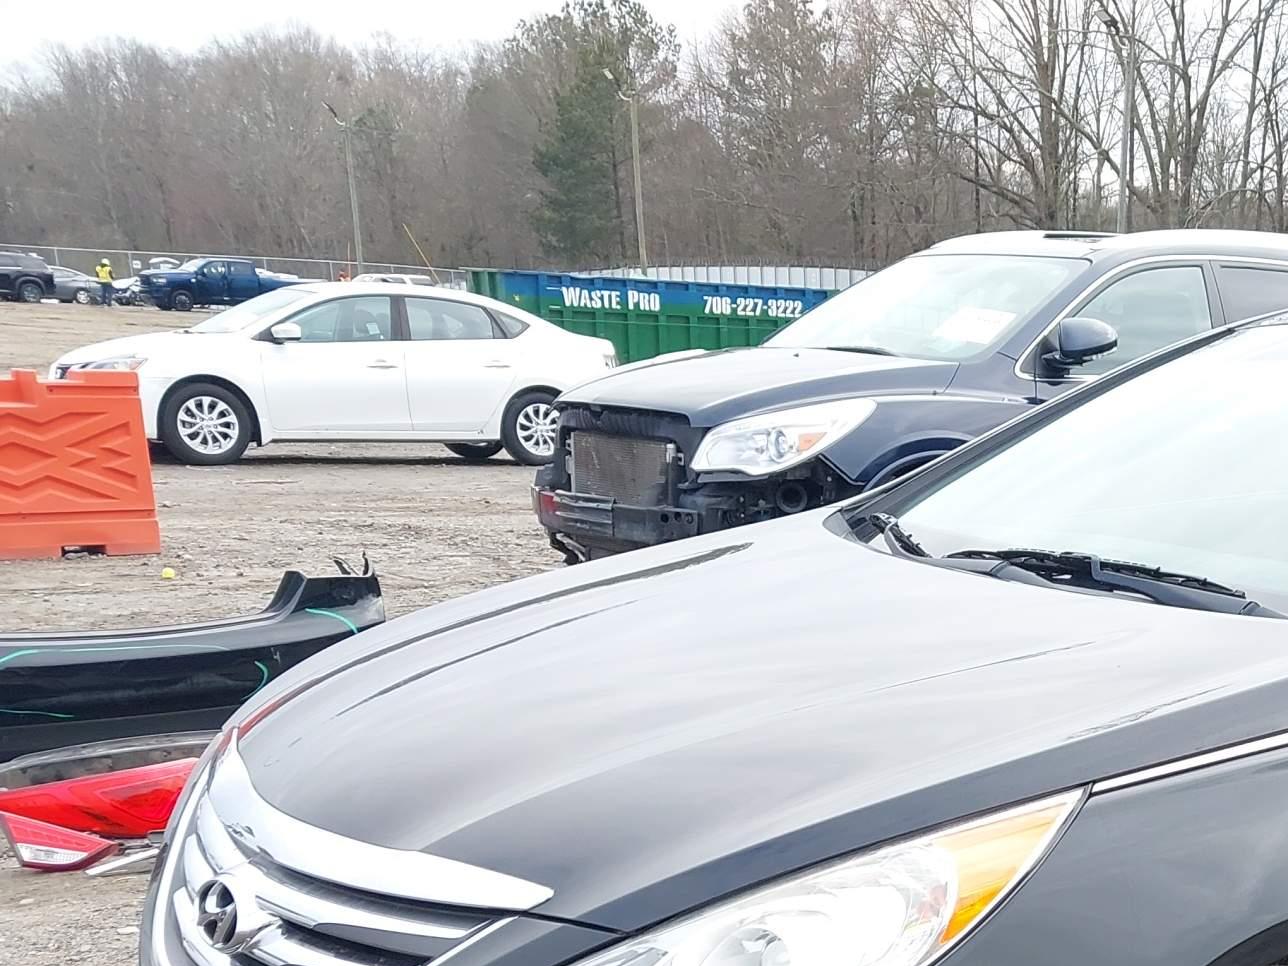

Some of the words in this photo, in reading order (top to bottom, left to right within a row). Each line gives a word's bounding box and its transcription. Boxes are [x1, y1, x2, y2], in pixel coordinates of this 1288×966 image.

[561, 286, 621, 310] WASTE
[627, 289, 661, 312] PRO
[703, 295, 803, 318] 706-227-3222
